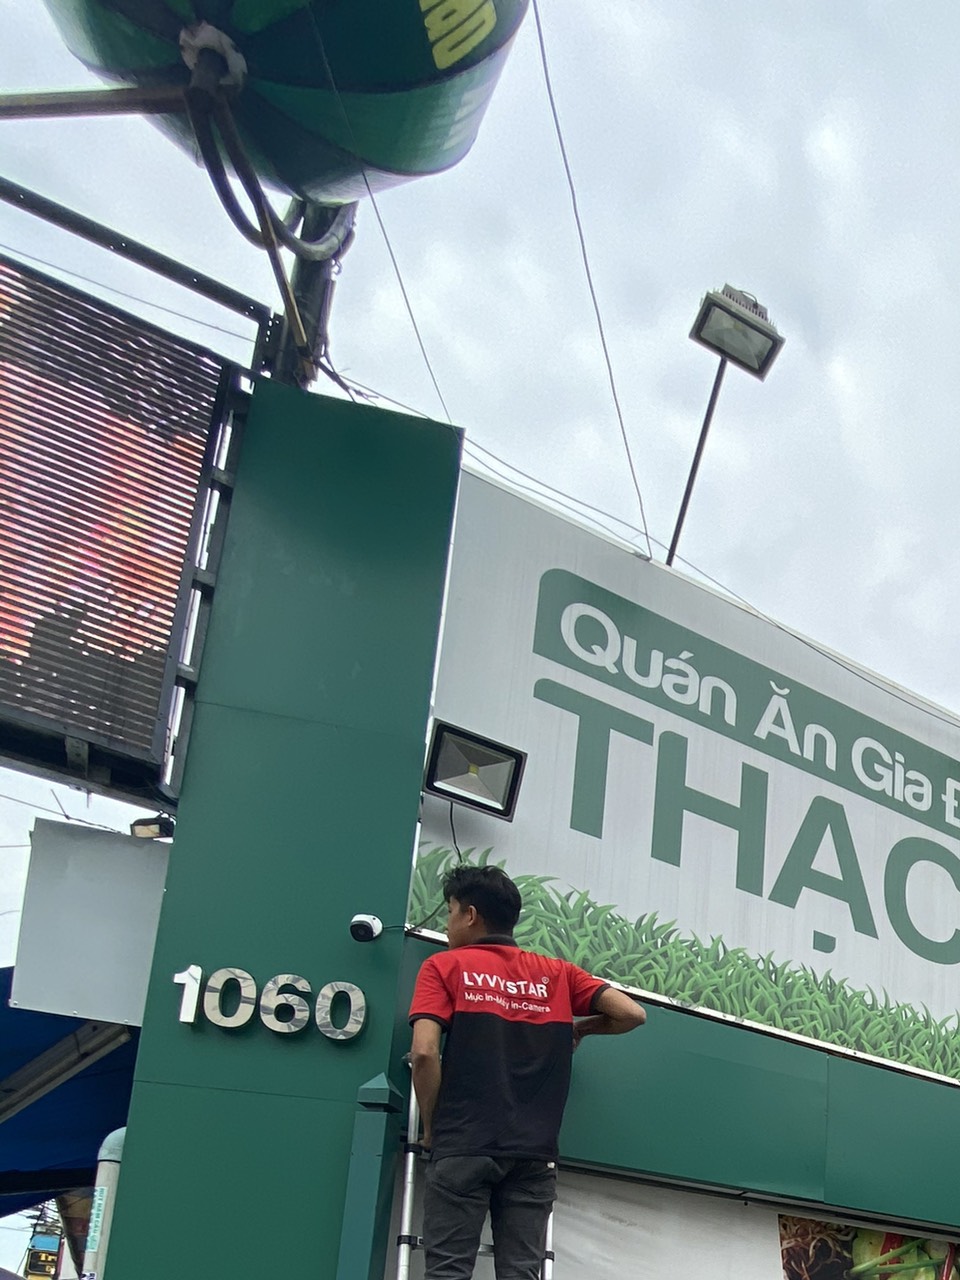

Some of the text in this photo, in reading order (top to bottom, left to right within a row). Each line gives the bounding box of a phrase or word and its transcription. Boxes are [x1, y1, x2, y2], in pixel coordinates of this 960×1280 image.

[560, 602, 737, 727] Quán
[754, 680, 837, 771] Ăn
[851, 736, 932, 812] Gia
[172, 963, 367, 1041] 1060
